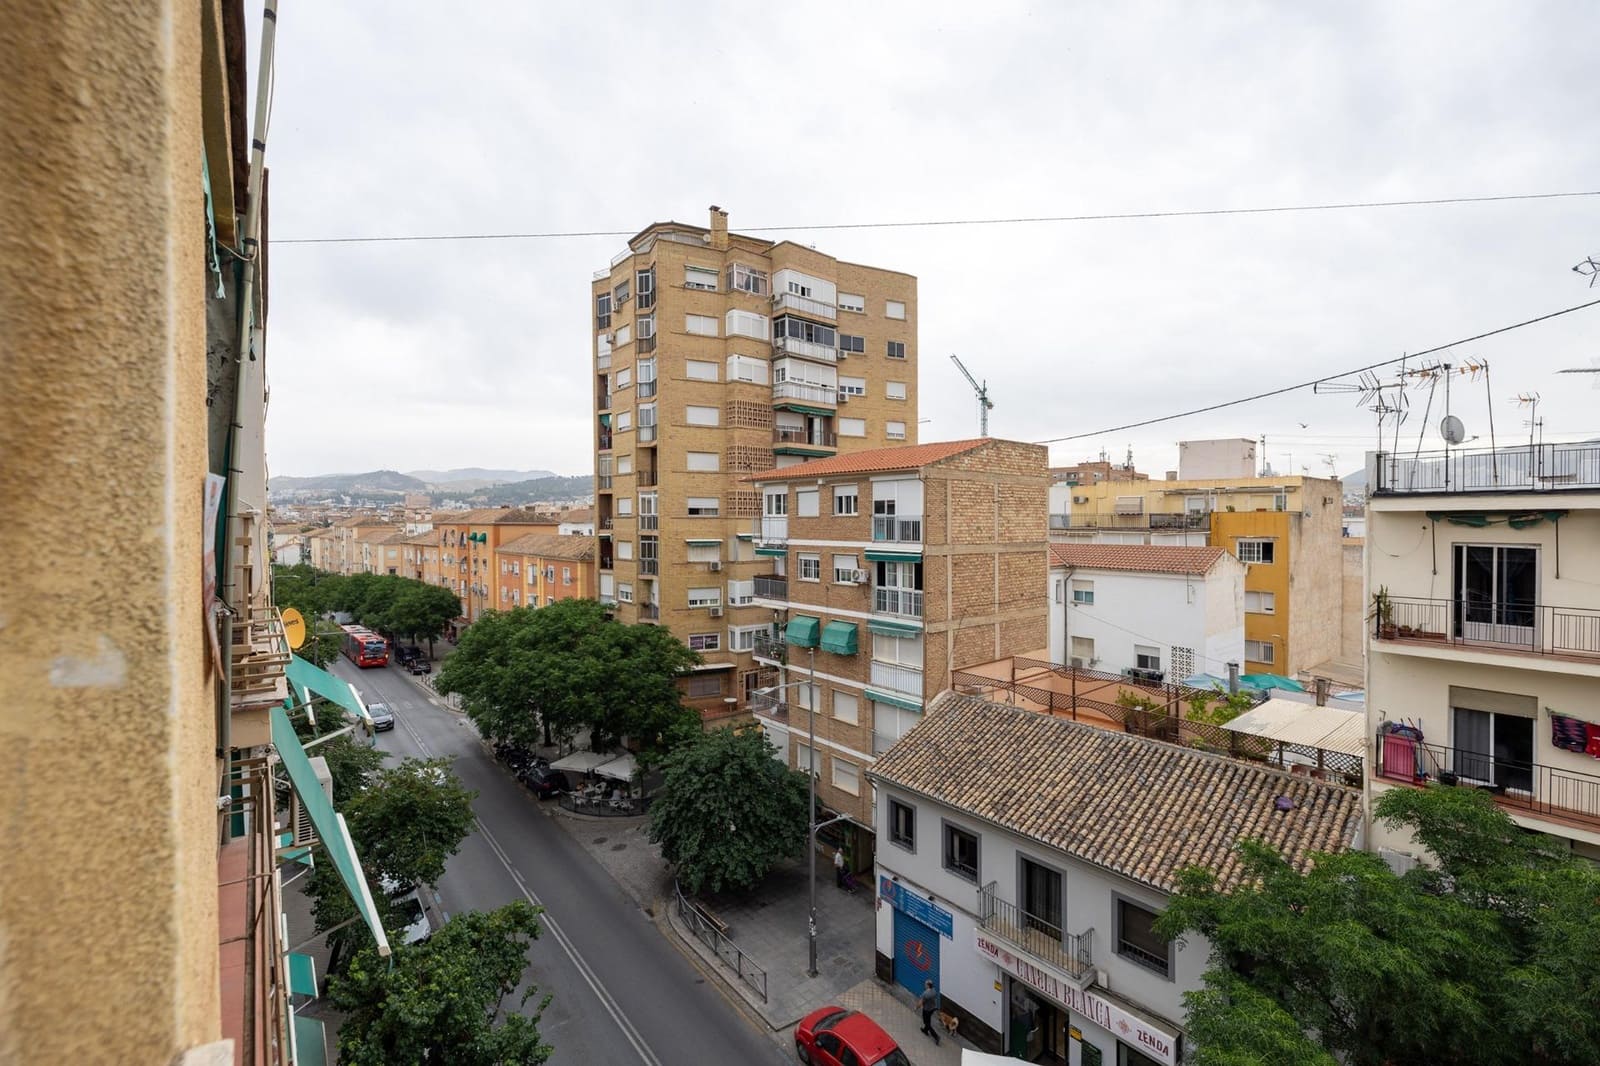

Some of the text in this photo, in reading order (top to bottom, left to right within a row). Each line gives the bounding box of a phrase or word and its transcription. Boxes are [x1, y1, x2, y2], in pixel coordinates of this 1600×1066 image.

[977, 937, 999, 957] ZENDA
[1064, 983, 1112, 1030] BLANCA
[1136, 1029, 1169, 1056] ZENDA
